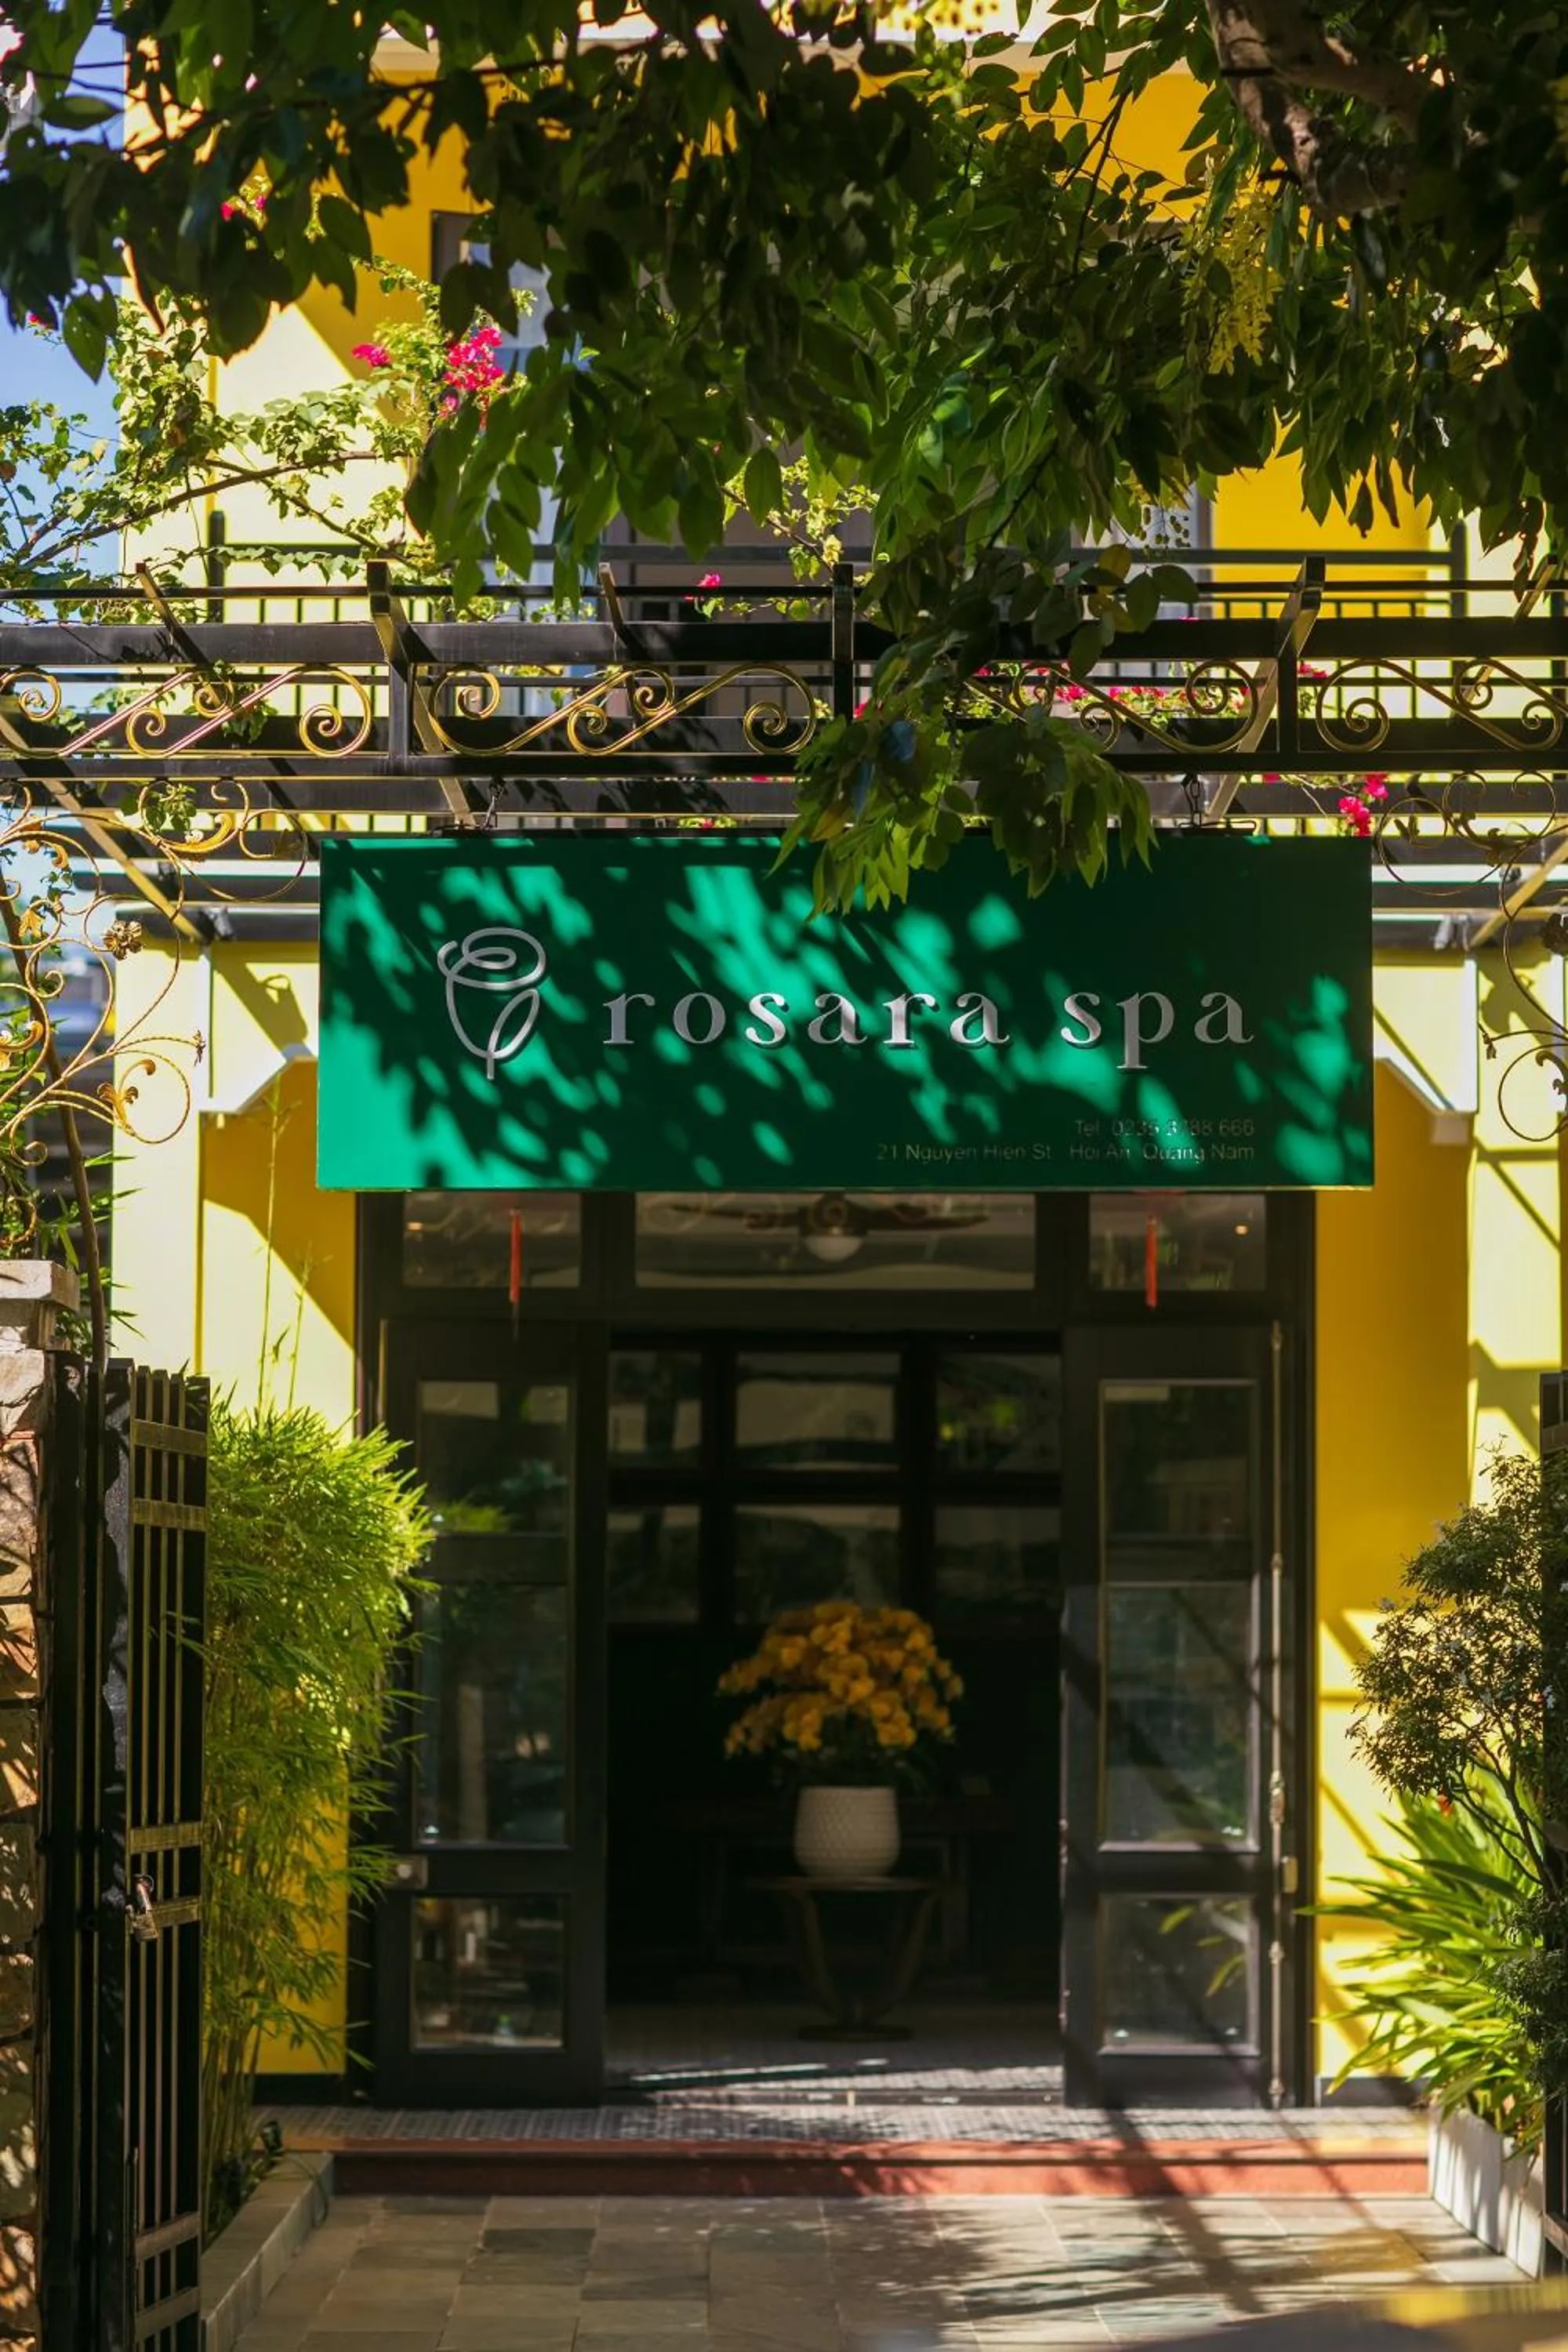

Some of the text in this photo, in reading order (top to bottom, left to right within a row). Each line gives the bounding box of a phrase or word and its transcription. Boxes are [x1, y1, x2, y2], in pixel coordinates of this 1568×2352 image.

[602, 991, 1254, 1069] rosara spa
[877, 1143, 897, 1160] 21
[906, 1143, 977, 1164] Nguyen
[984, 1143, 1026, 1160] Hien
[1143, 1143, 1205, 1165] Quang
[1211, 1143, 1254, 1160] Nam
